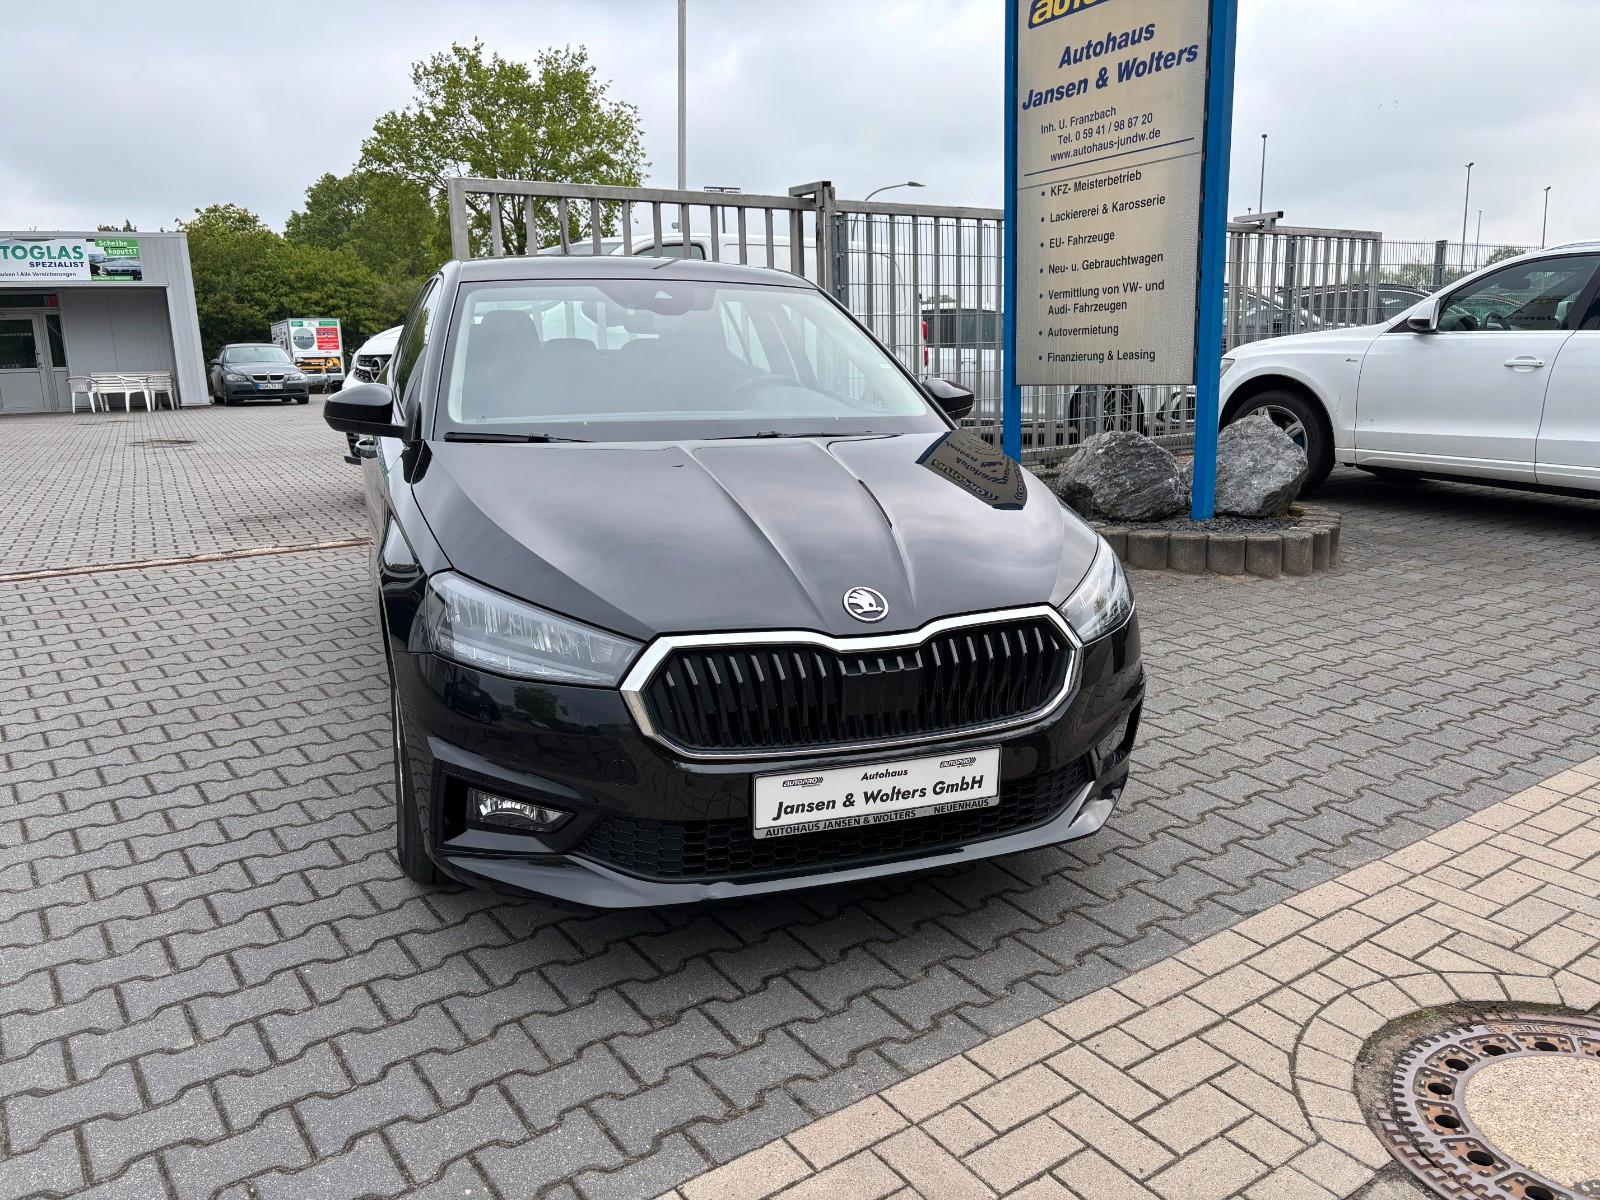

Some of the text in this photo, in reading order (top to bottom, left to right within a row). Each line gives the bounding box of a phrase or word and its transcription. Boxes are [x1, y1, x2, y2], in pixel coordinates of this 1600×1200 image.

[1058, 23, 1155, 69] Autohaus
[1022, 44, 1199, 110] Jansen & Wolters
[1041, 106, 1117, 135] Inh. U. Franzbach
[1058, 133, 1073, 145] Tel.
[1075, 130, 1081, 141] 0
[1083, 127, 1094, 139] 59
[1095, 125, 1105, 137] 41
[1114, 120, 1125, 132] 98
[1127, 117, 1138, 128] 87
[1141, 112, 1153, 125] 20
[1050, 128, 1161, 162] www.autohaus-jundw.de
[1051, 170, 1142, 197] KFZ- Meisterbetrieb
[1050, 194, 1166, 223] Lackiererei & Karosserie
[0, 245, 84, 260] TOGLAS
[1049, 230, 1115, 249] EU- Fahrzeuge
[1048, 252, 1164, 275] Neu- u. Gebrauchtwagen
[1048, 279, 1165, 300] Vermittlung von VW- und
[1048, 300, 1128, 316] Audi- Fahrzeugen
[1047, 324, 1119, 337] Autovermietung
[1047, 349, 1156, 363] Finanzierung & Leasing
[861, 768, 908, 781] Autohaus
[772, 775, 984, 821] Jansen & Wolters GmbH
[765, 799, 989, 838] AUTOHAUS JANSEN & WOLTERS NEUENHAUS
